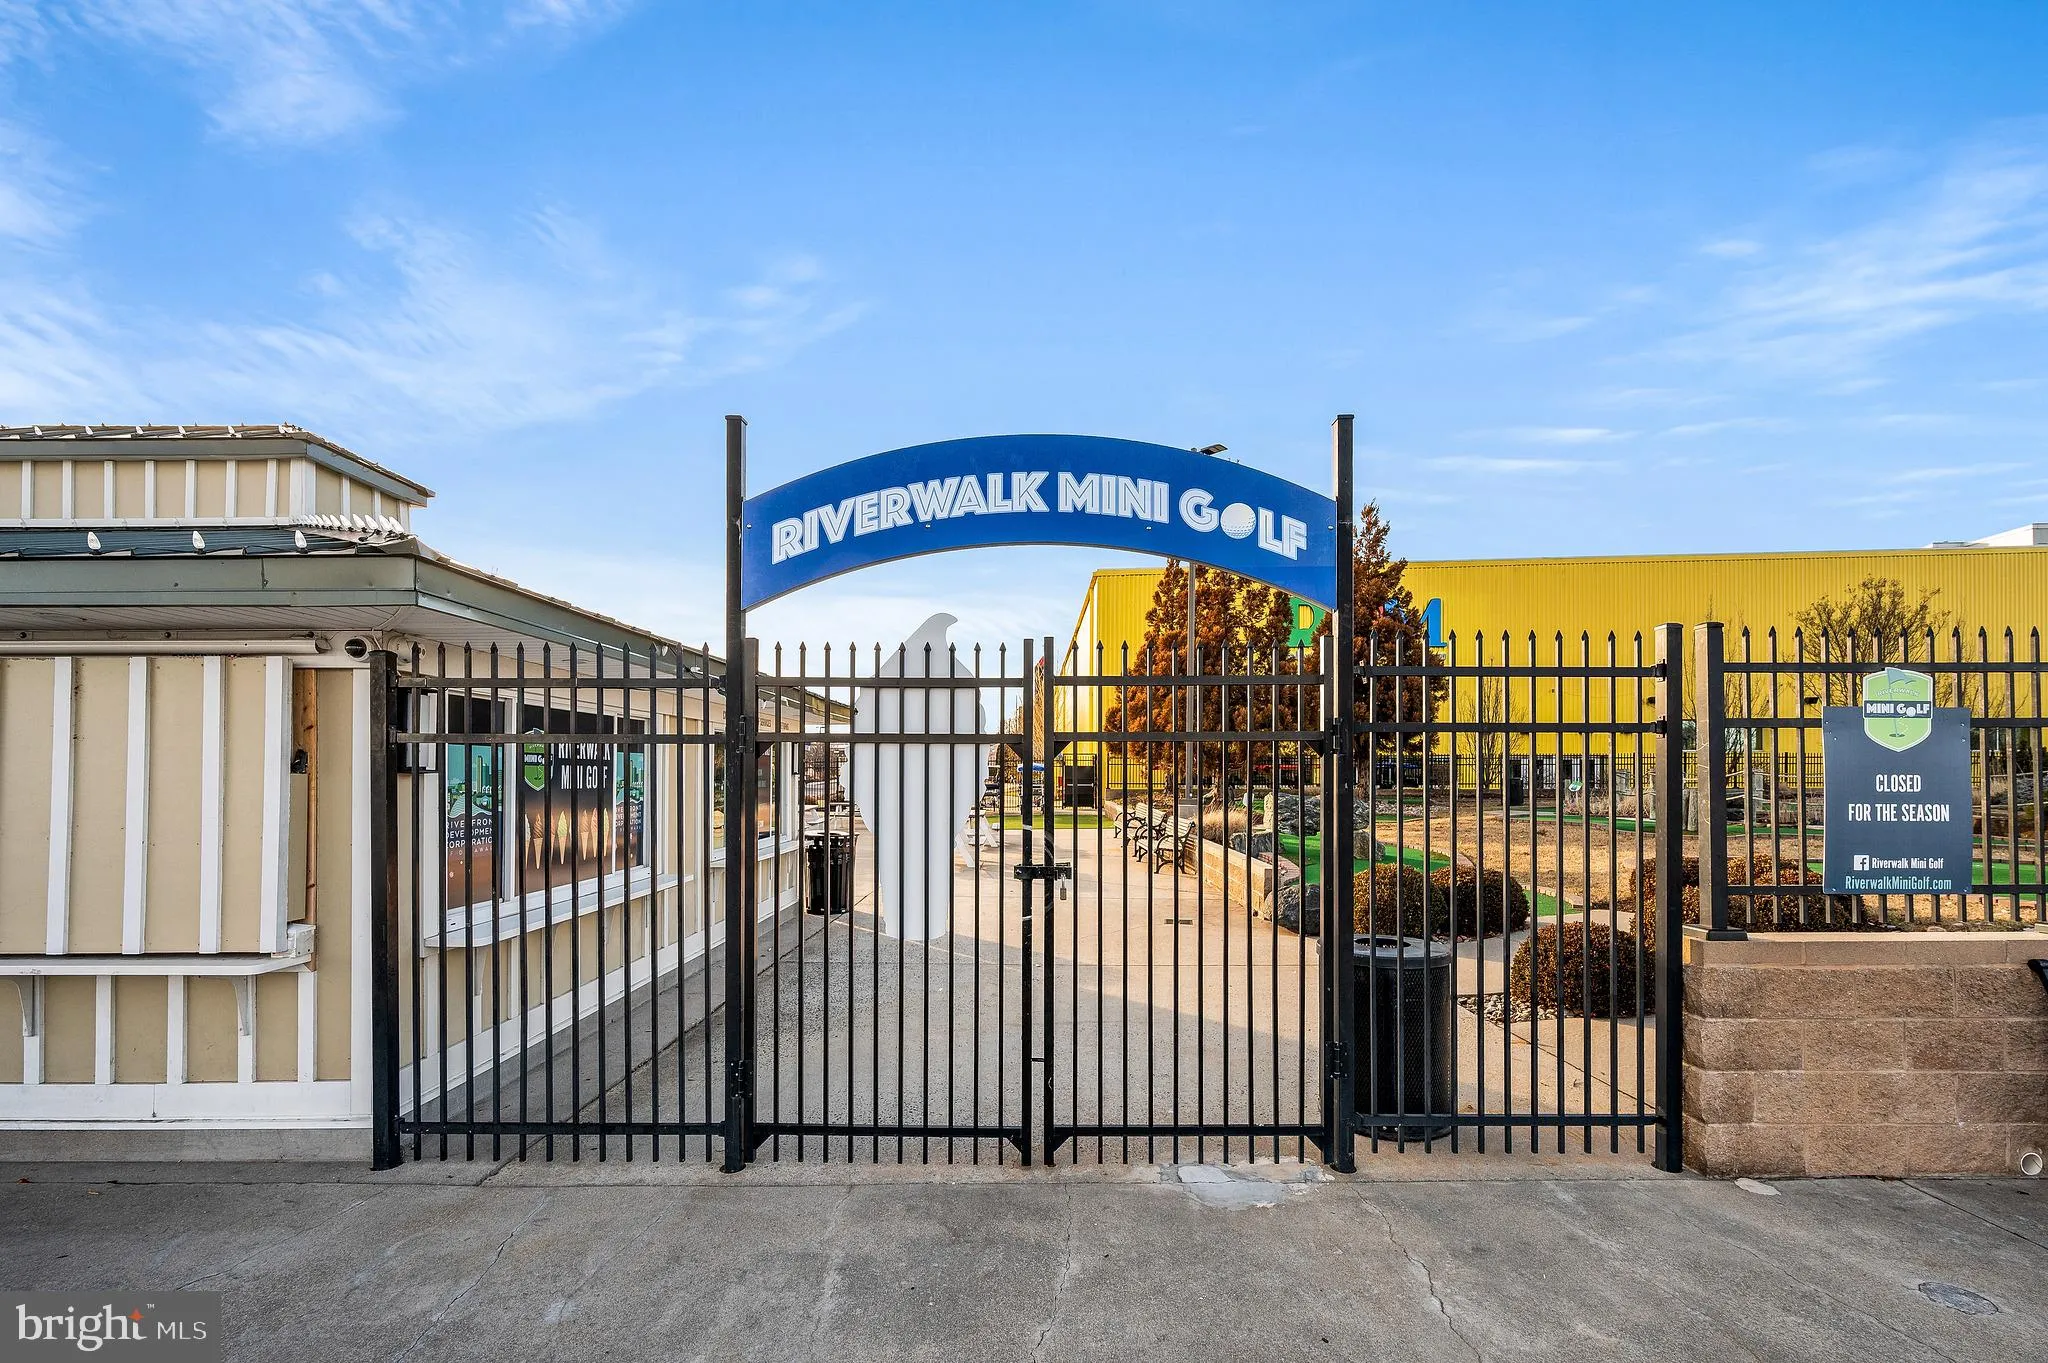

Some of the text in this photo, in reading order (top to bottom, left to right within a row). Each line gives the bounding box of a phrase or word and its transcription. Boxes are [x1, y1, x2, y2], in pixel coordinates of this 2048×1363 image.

[771, 470, 1308, 565] RIVERWALK MINI GOLF
[1866, 703, 1930, 717] MINI GOLF
[586, 764, 608, 790] GOF
[1875, 774, 1921, 793] CLOSED
[1848, 803, 1950, 822] FOR THE SEASON
[446, 818, 493, 829] RIVEFRON
[1871, 857, 1909, 869] Riverwalk
[1910, 857, 1927, 869] Mini
[1928, 857, 1944, 869] Golf
[1845, 875, 1952, 890] RiverwalkMiniGolf.com
